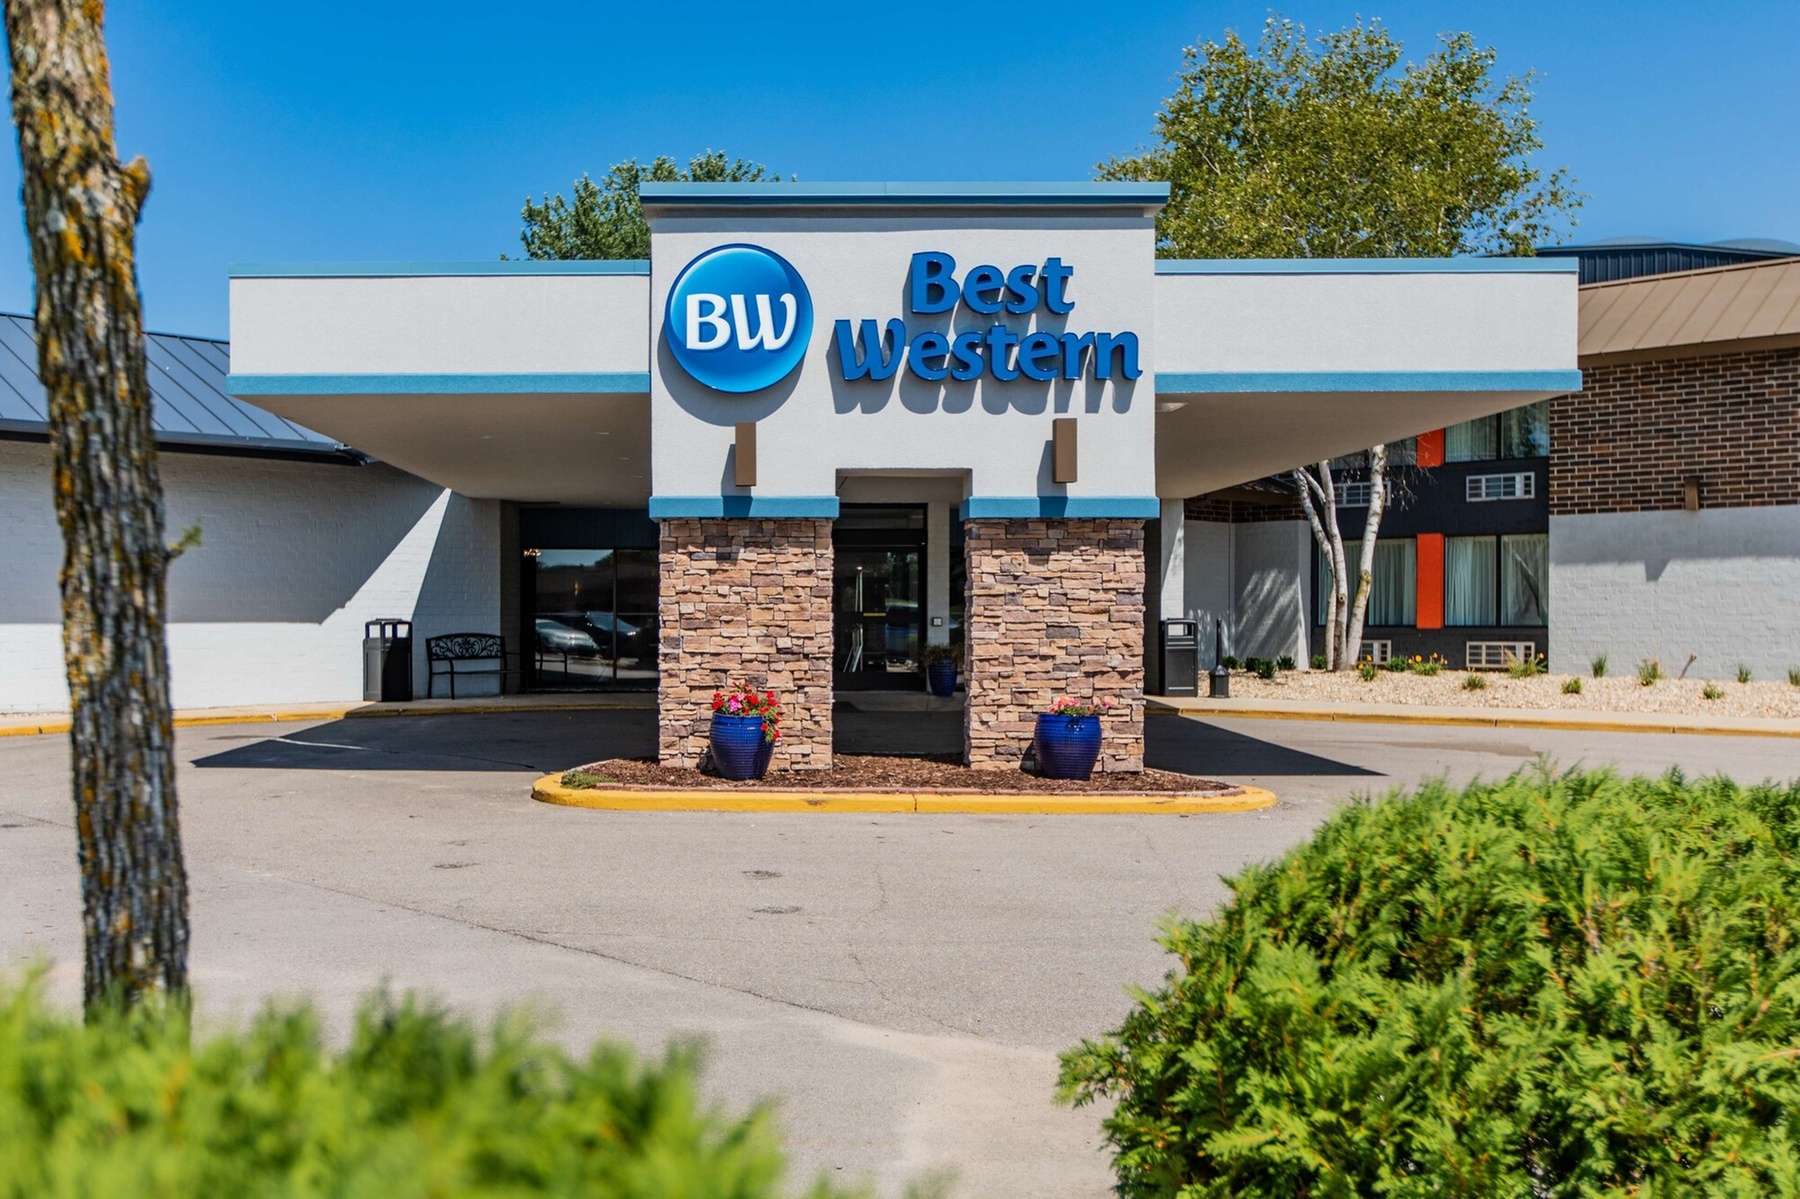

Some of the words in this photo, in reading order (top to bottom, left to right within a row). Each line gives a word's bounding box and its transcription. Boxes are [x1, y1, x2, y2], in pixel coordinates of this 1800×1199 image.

[910, 251, 1075, 314] Best
[686, 293, 797, 351] BW
[834, 317, 1143, 382] Western
